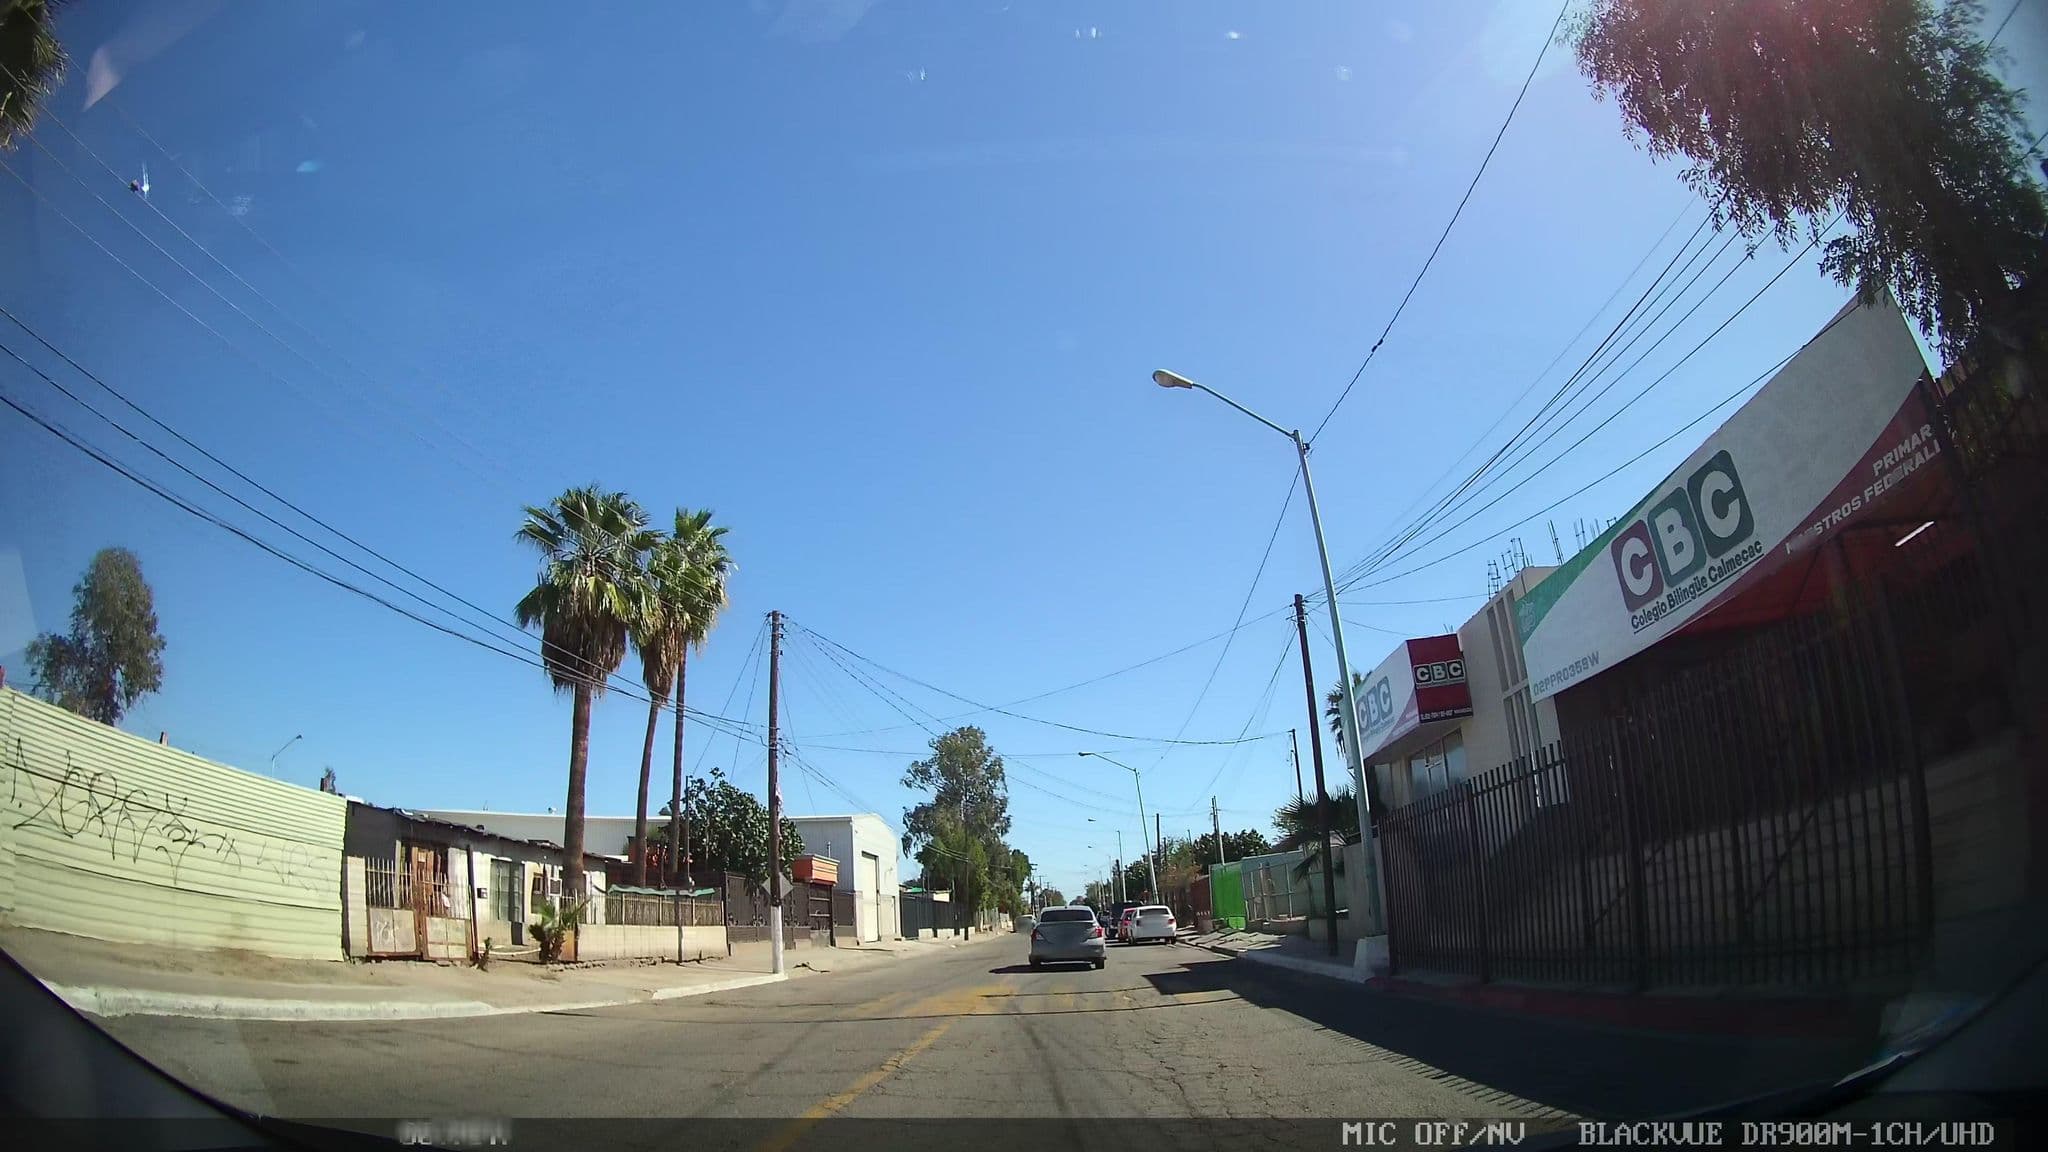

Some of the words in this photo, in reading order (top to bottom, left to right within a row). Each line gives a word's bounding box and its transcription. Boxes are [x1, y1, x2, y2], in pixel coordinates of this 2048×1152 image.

[1620, 468, 1743, 598] CBC
[1785, 495, 1862, 554] STROS
[1631, 598, 1667, 630] Colegio
[1666, 574, 1709, 609] Bilingüe
[1707, 539, 1764, 583] Calmecac
[1415, 661, 1463, 682] CBC
[1357, 681, 1391, 730] CBC
